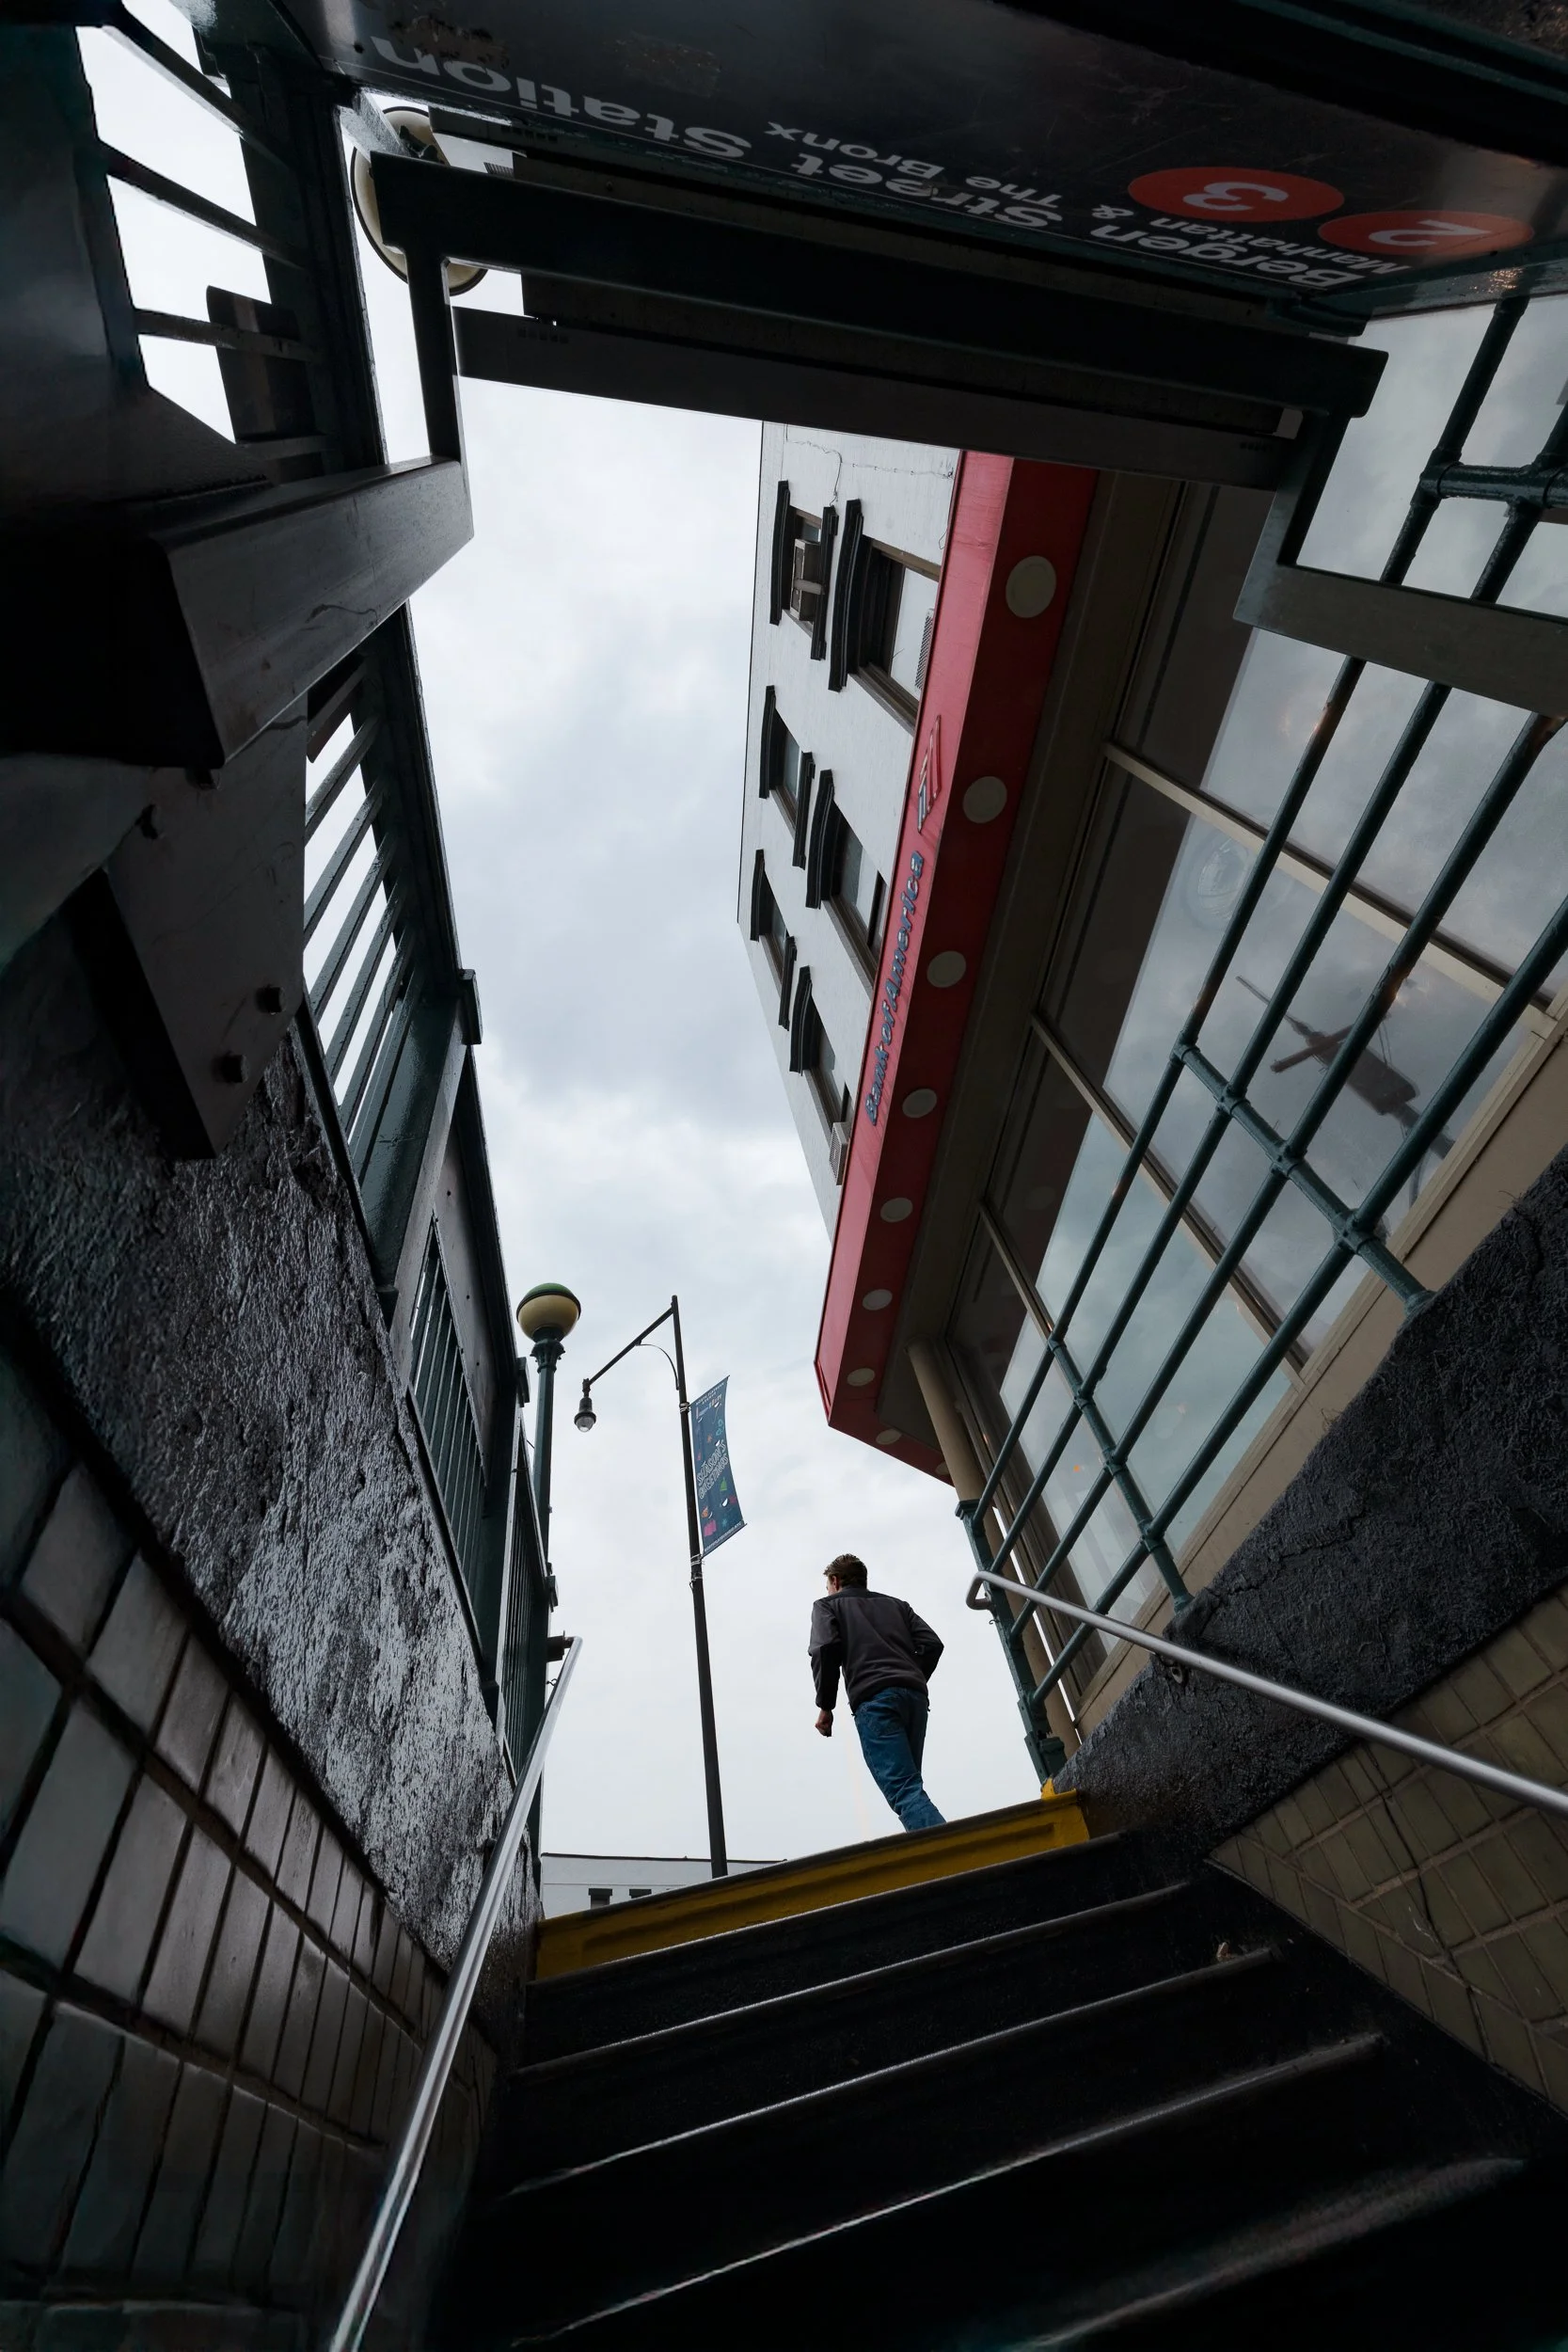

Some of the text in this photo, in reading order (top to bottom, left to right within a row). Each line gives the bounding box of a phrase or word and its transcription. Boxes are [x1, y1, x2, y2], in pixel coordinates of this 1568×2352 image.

[371, 35, 1368, 289] Bergen Street Station
[764, 120, 1411, 275] Manhattan & The Bronx
[1182, 181, 1493, 247] 2 3
[865, 850, 925, 1126] Bank of America
